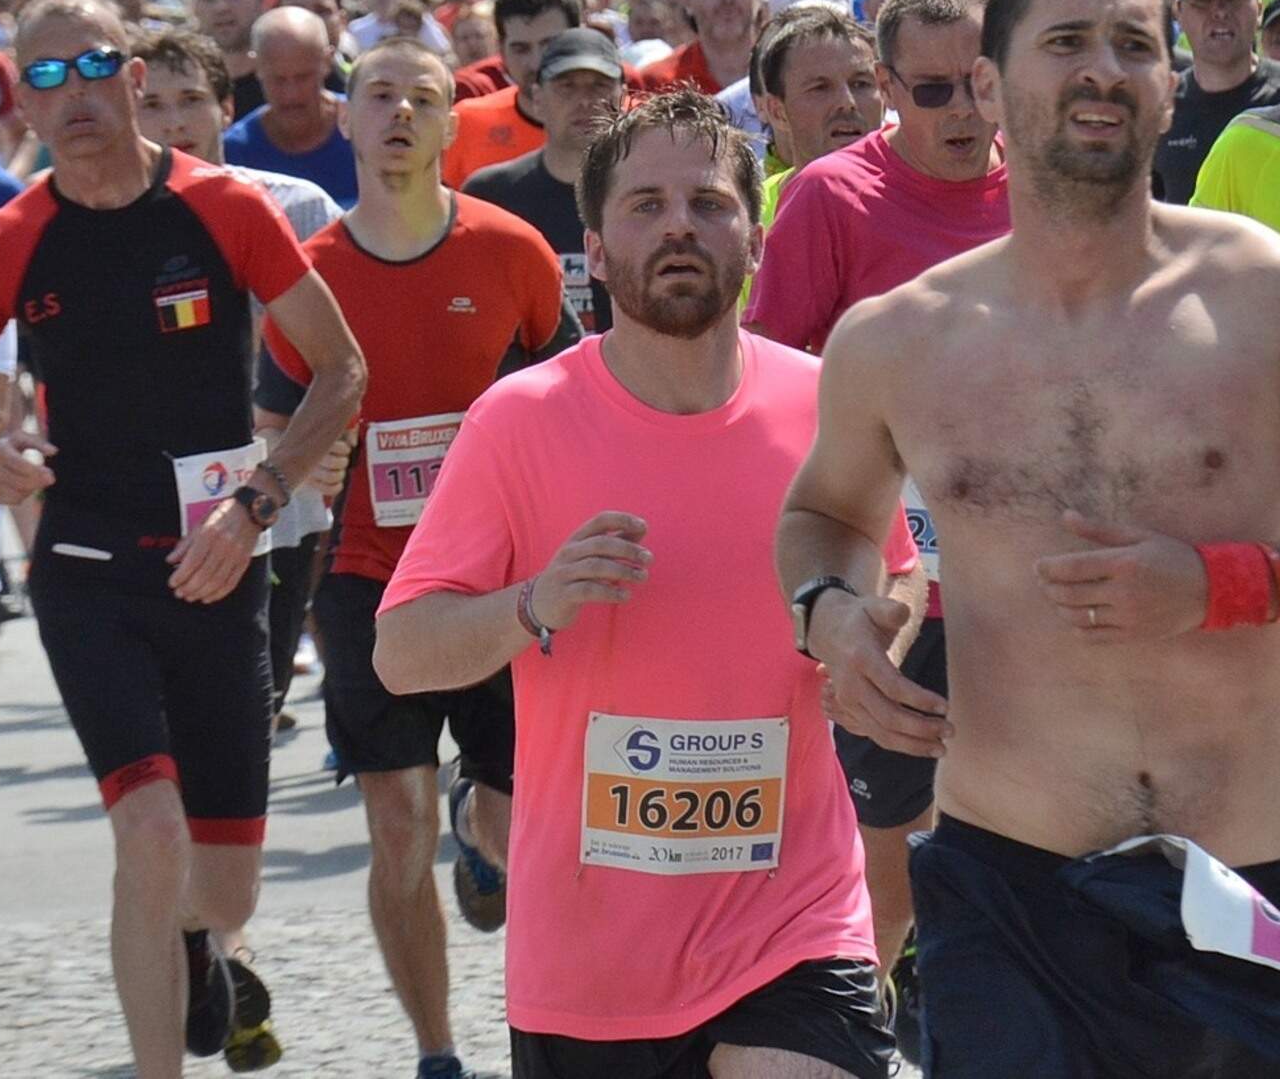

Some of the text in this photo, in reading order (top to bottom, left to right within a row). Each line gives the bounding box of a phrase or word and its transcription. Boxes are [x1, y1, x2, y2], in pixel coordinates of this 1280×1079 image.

[670, 734, 746, 751] GROUP
[751, 732, 764, 749] S
[668, 766, 720, 774] MANAGEMENT
[611, 785, 762, 831] 16206
[711, 846, 744, 861] 2017
